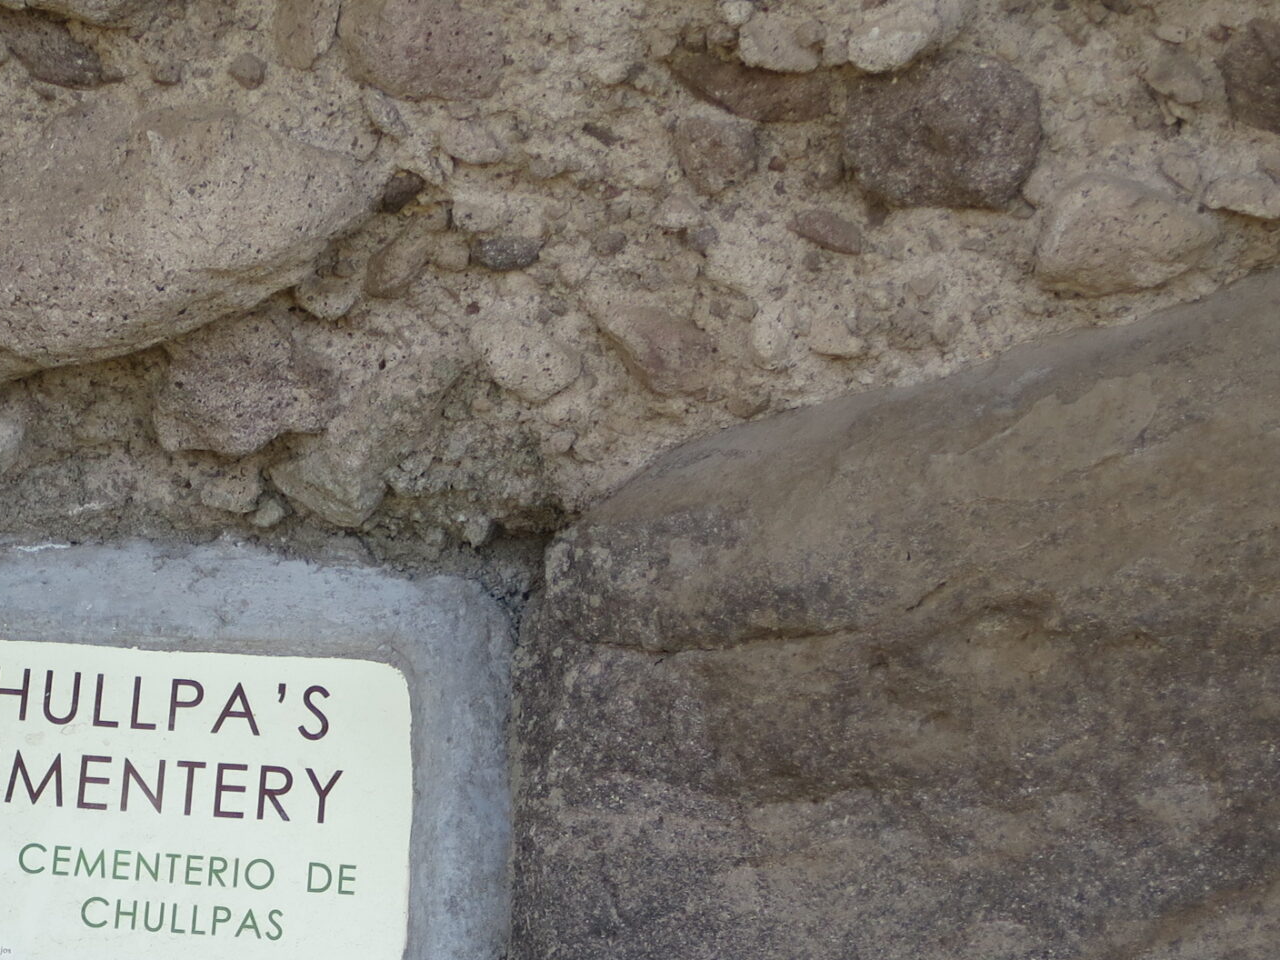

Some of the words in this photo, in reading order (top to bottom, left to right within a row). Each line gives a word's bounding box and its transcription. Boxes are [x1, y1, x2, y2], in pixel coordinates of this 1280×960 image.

[19, 843, 275, 891] CEMENTERIO
[307, 862, 357, 895] DE
[80, 896, 285, 941] CHULLPAS
